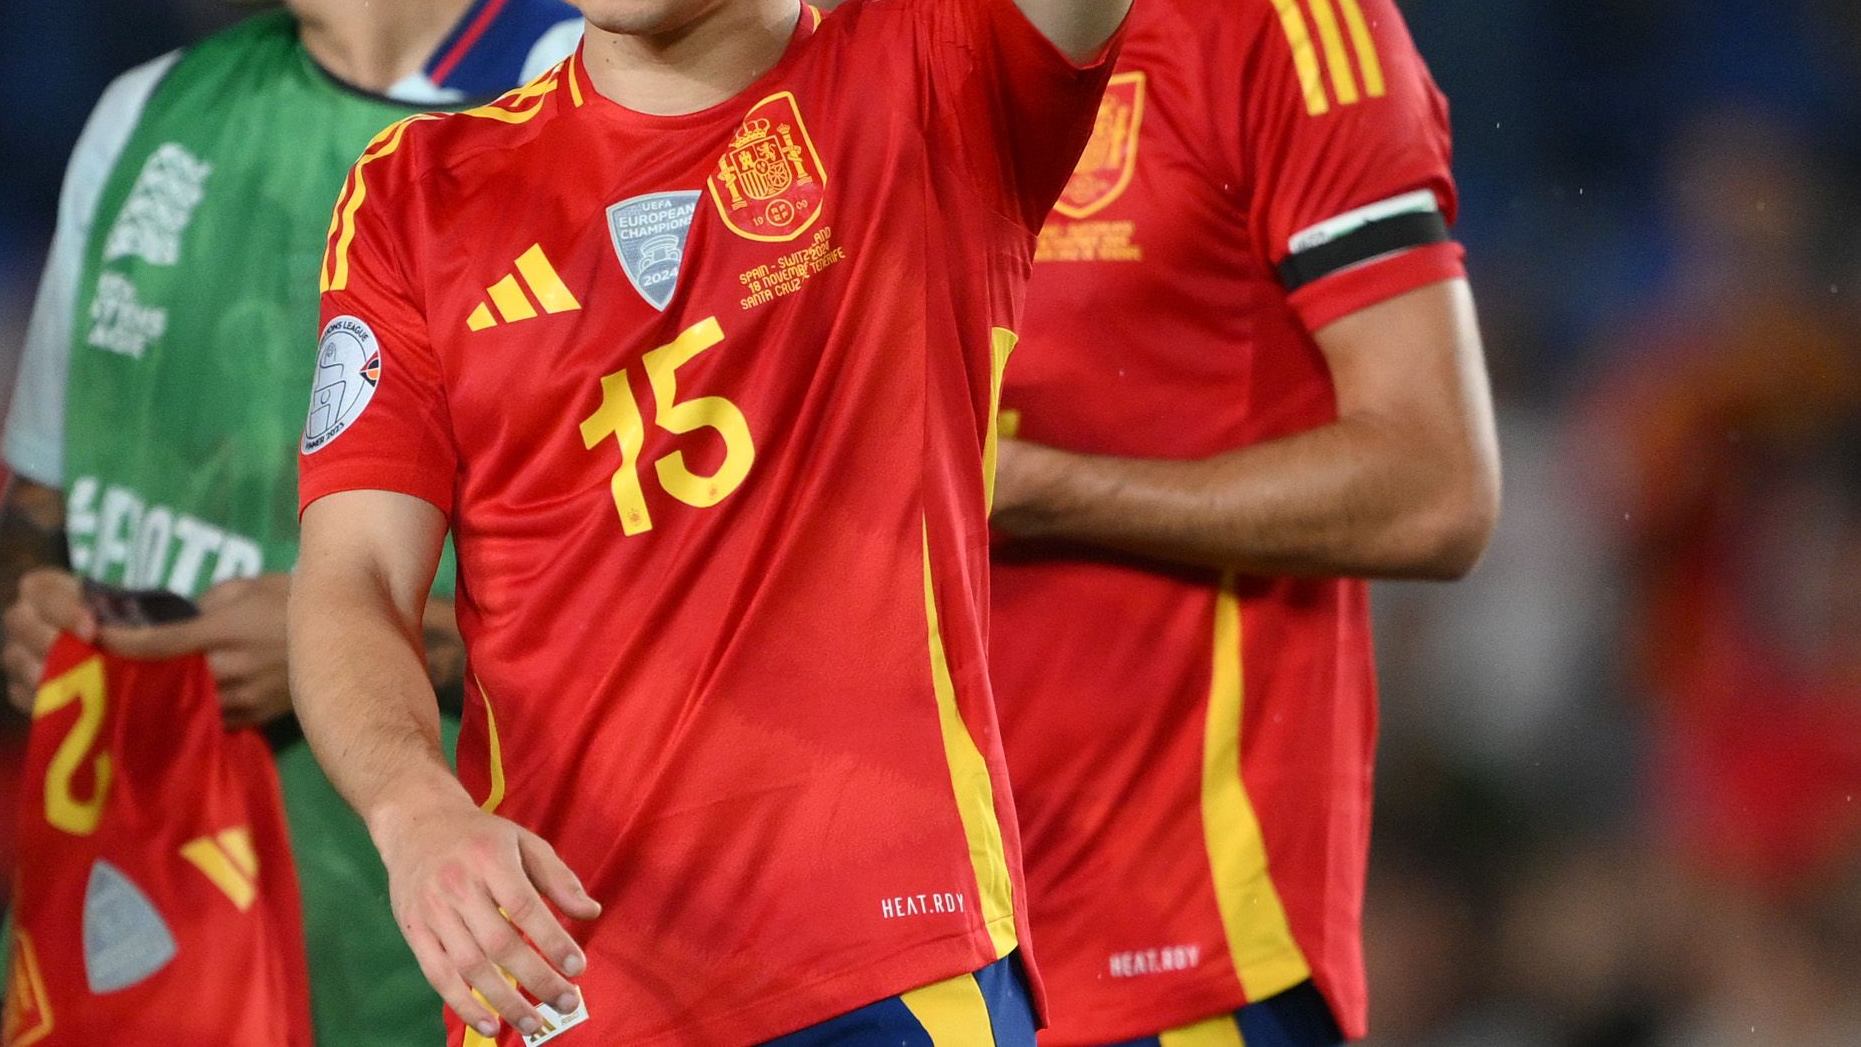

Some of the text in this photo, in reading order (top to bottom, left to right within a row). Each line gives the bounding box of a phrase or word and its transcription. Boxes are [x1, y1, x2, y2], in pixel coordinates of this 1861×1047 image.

[619, 203, 695, 228] EUROPEAN
[642, 199, 672, 211] UEFA
[739, 264, 770, 285] SPAIN
[740, 289, 774, 310] SANTA
[775, 278, 802, 297] CRUZ
[748, 280, 762, 293] 18
[343, 321, 369, 342] LEAGUE
[579, 315, 755, 536] 15
[881, 893, 964, 919] HEAT.RDY
